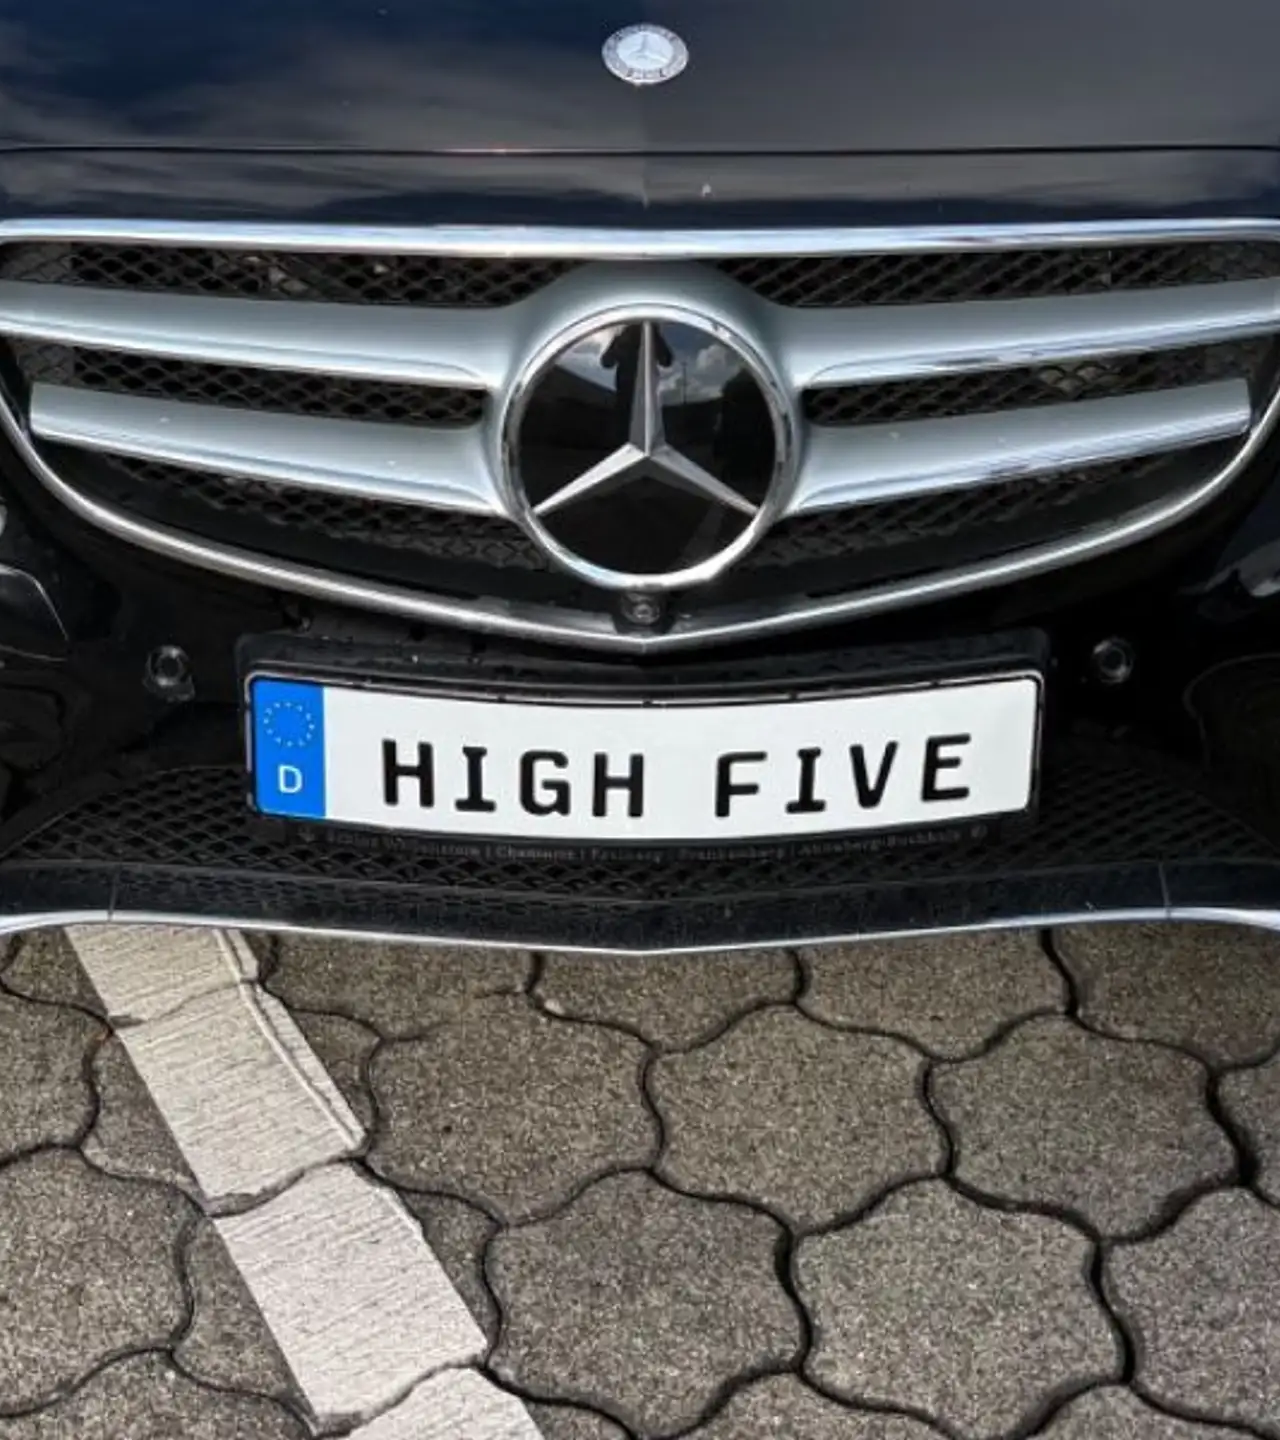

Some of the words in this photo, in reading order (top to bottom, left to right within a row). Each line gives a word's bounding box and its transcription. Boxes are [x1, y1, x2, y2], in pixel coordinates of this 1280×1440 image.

[277, 764, 303, 795] D
[381, 737, 645, 819] HIGH
[715, 732, 972, 820] FIVE
